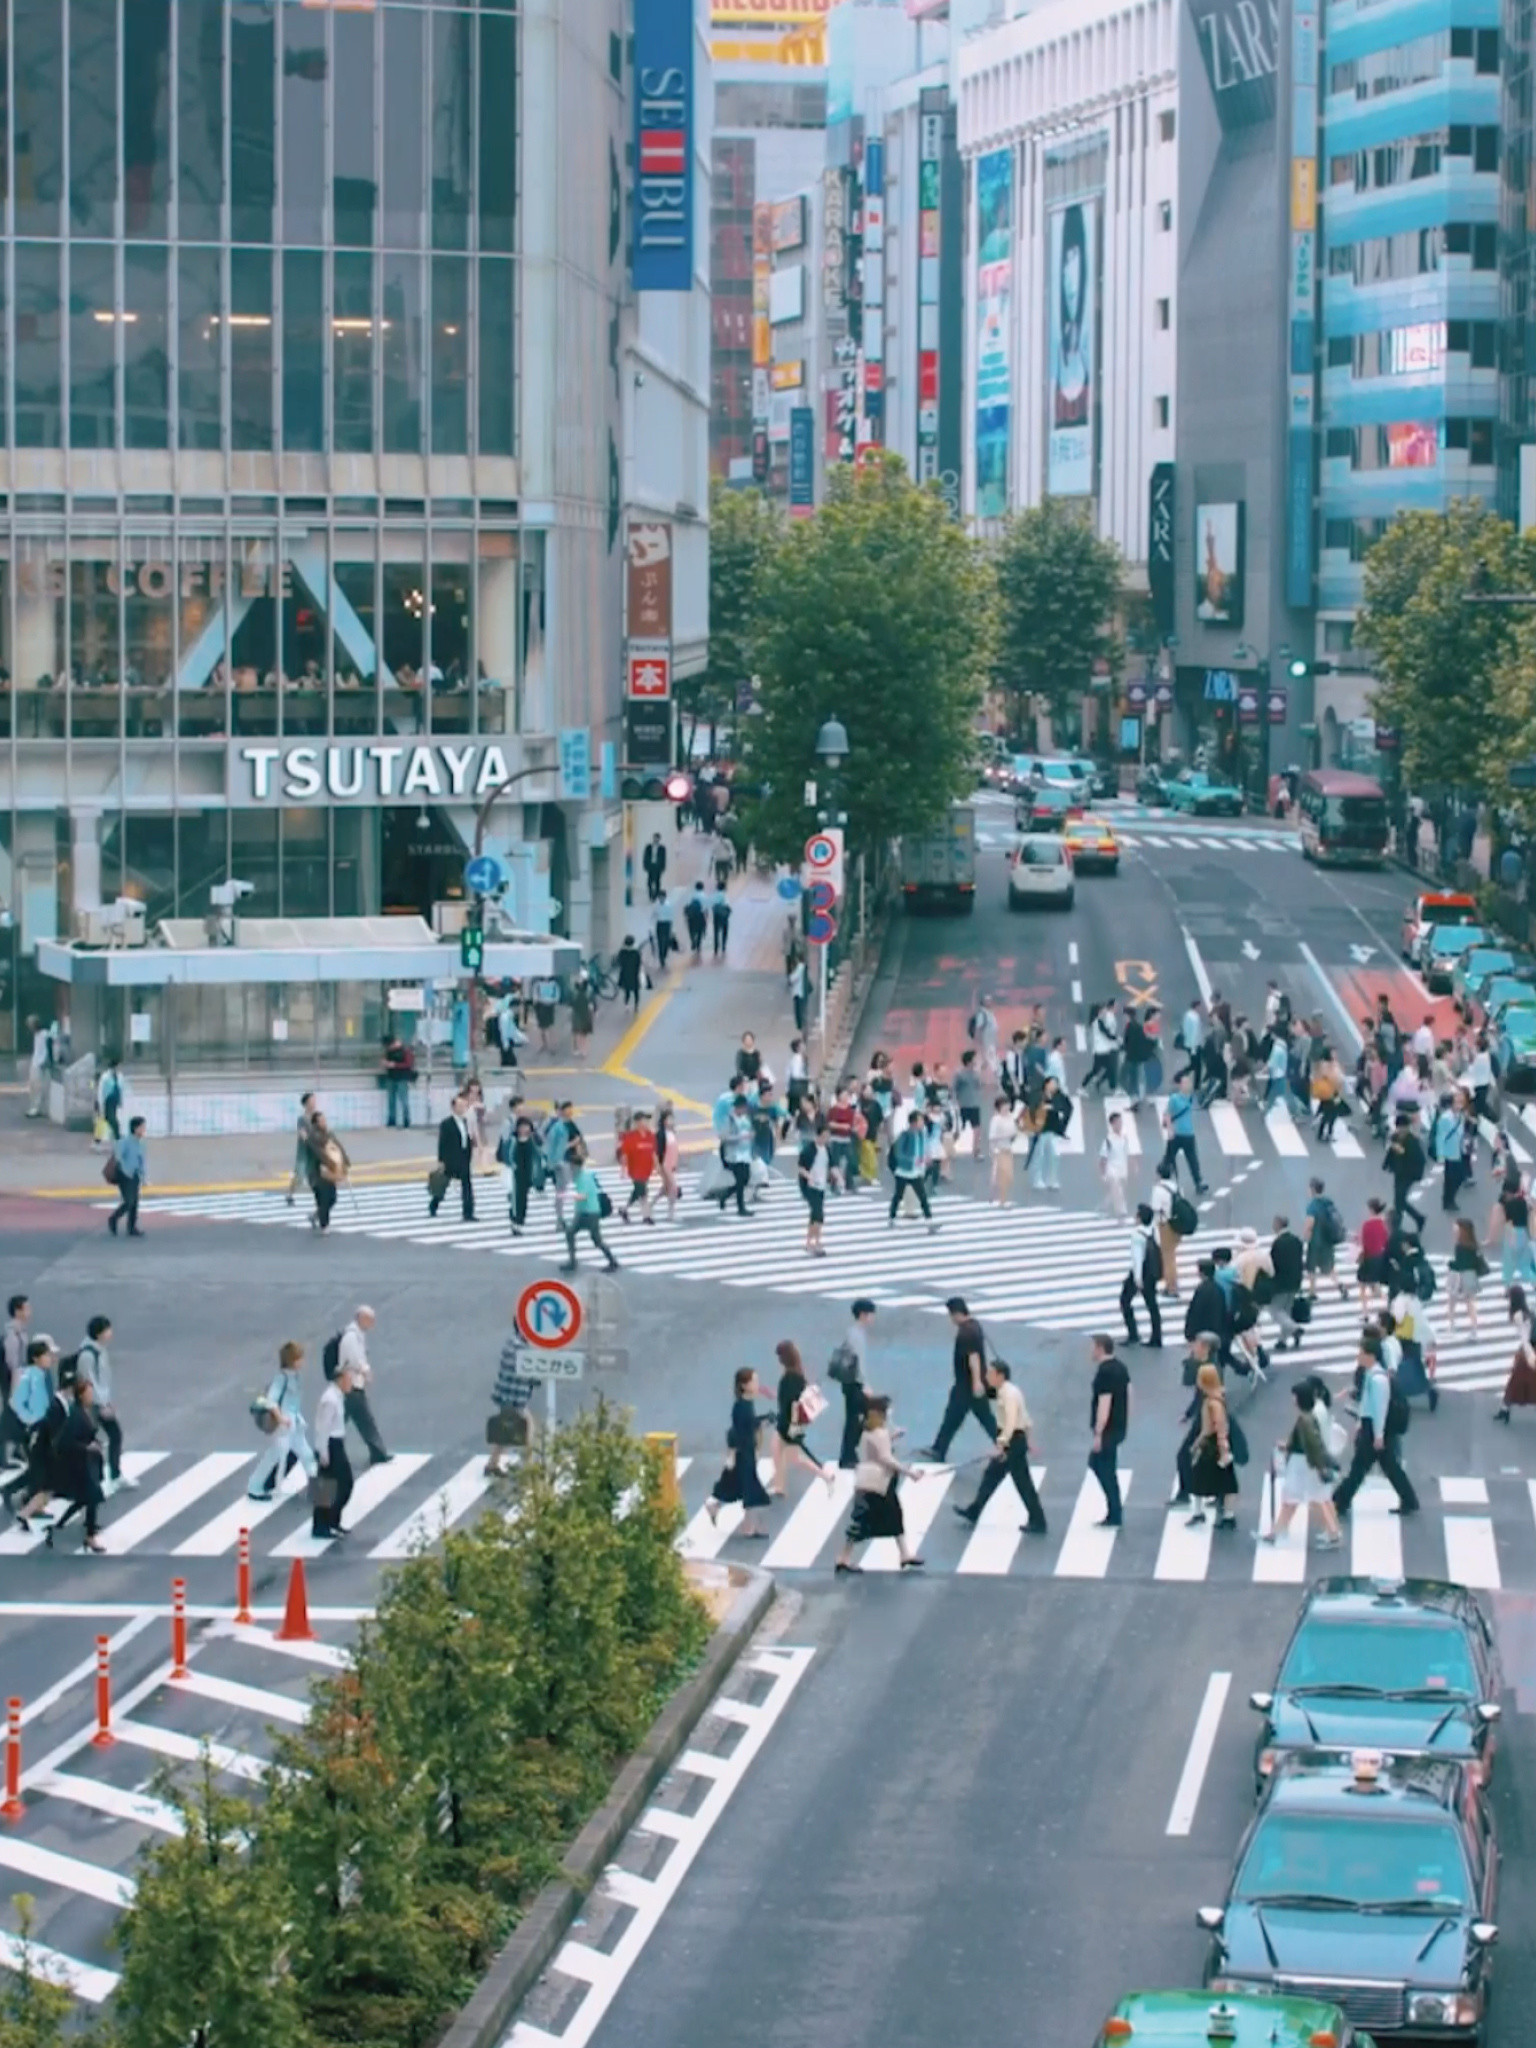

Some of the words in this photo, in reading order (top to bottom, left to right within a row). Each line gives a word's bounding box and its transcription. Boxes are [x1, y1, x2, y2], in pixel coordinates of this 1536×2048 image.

[640, 67, 686, 248] SEIBU
[823, 168, 844, 306] KARAOKE
[105, 559, 293, 599] COFFEE
[635, 662, 663, 692] 本
[242, 744, 514, 799] TSUTAYA
[521, 1357, 578, 1376] ここから
